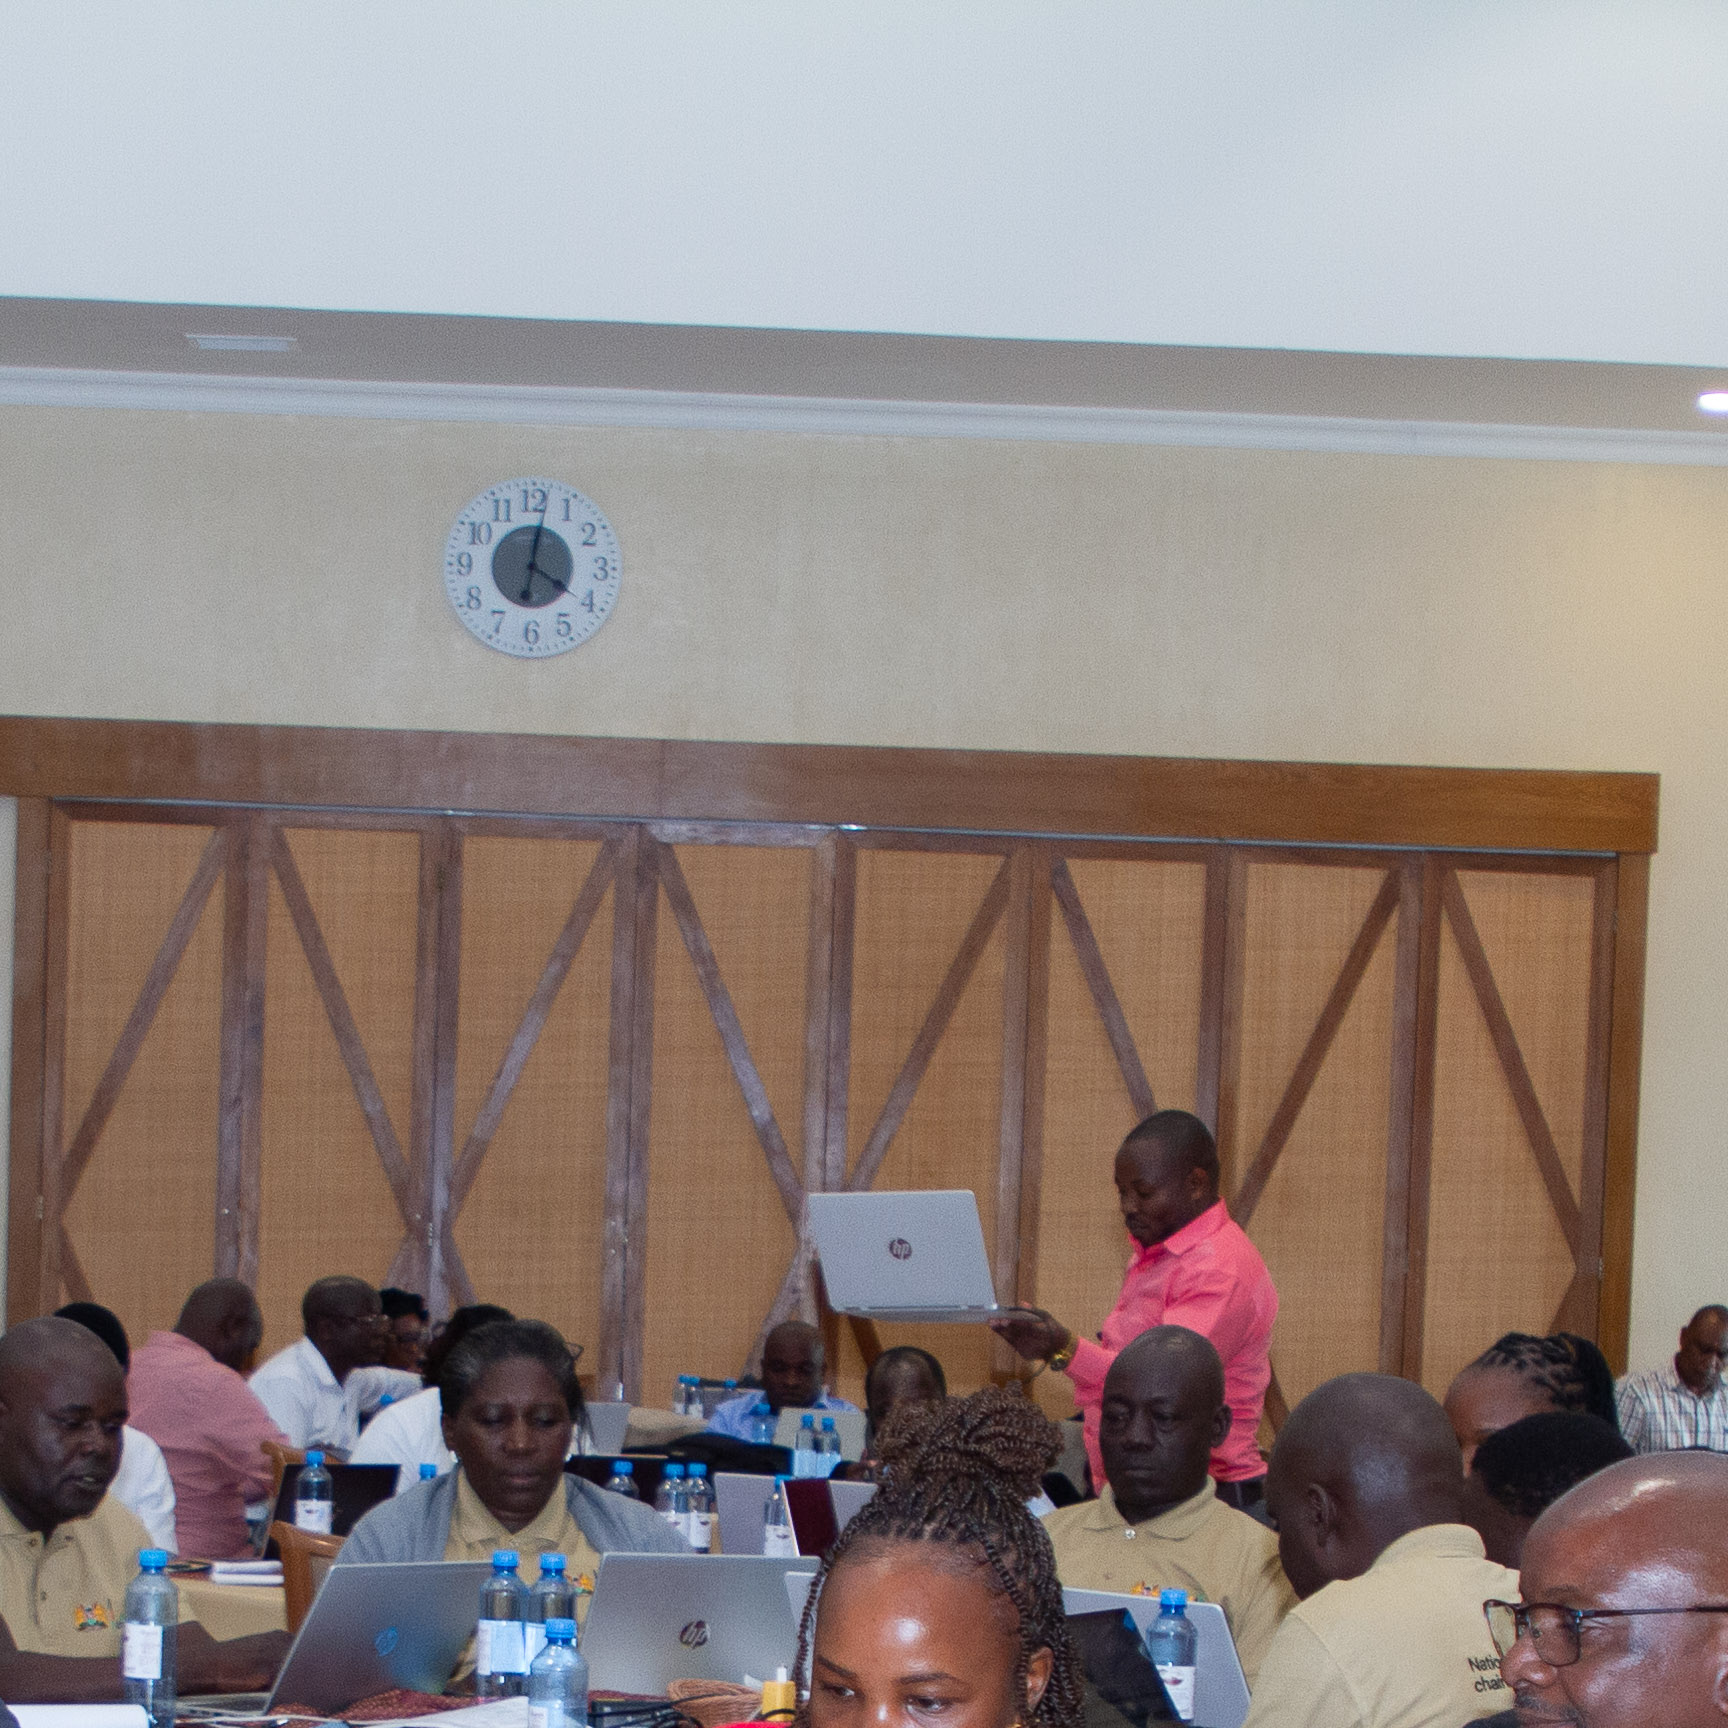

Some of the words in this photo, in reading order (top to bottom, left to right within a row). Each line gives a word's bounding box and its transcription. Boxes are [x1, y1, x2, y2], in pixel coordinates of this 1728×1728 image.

[492, 498, 511, 522] 11
[522, 488, 546, 513] 12
[562, 499, 572, 522] 1
[469, 521, 492, 545] 10
[581, 522, 597, 546] 2
[456, 551, 473, 576] 9
[593, 556, 609, 581] 3
[466, 585, 482, 610] 8
[580, 589, 595, 613] 4
[491, 609, 506, 634] 7
[524, 619, 540, 645] 6
[556, 612, 572, 637] 5
[889, 1238, 912, 1260] hp
[1467, 1654, 1502, 1673] Natio
